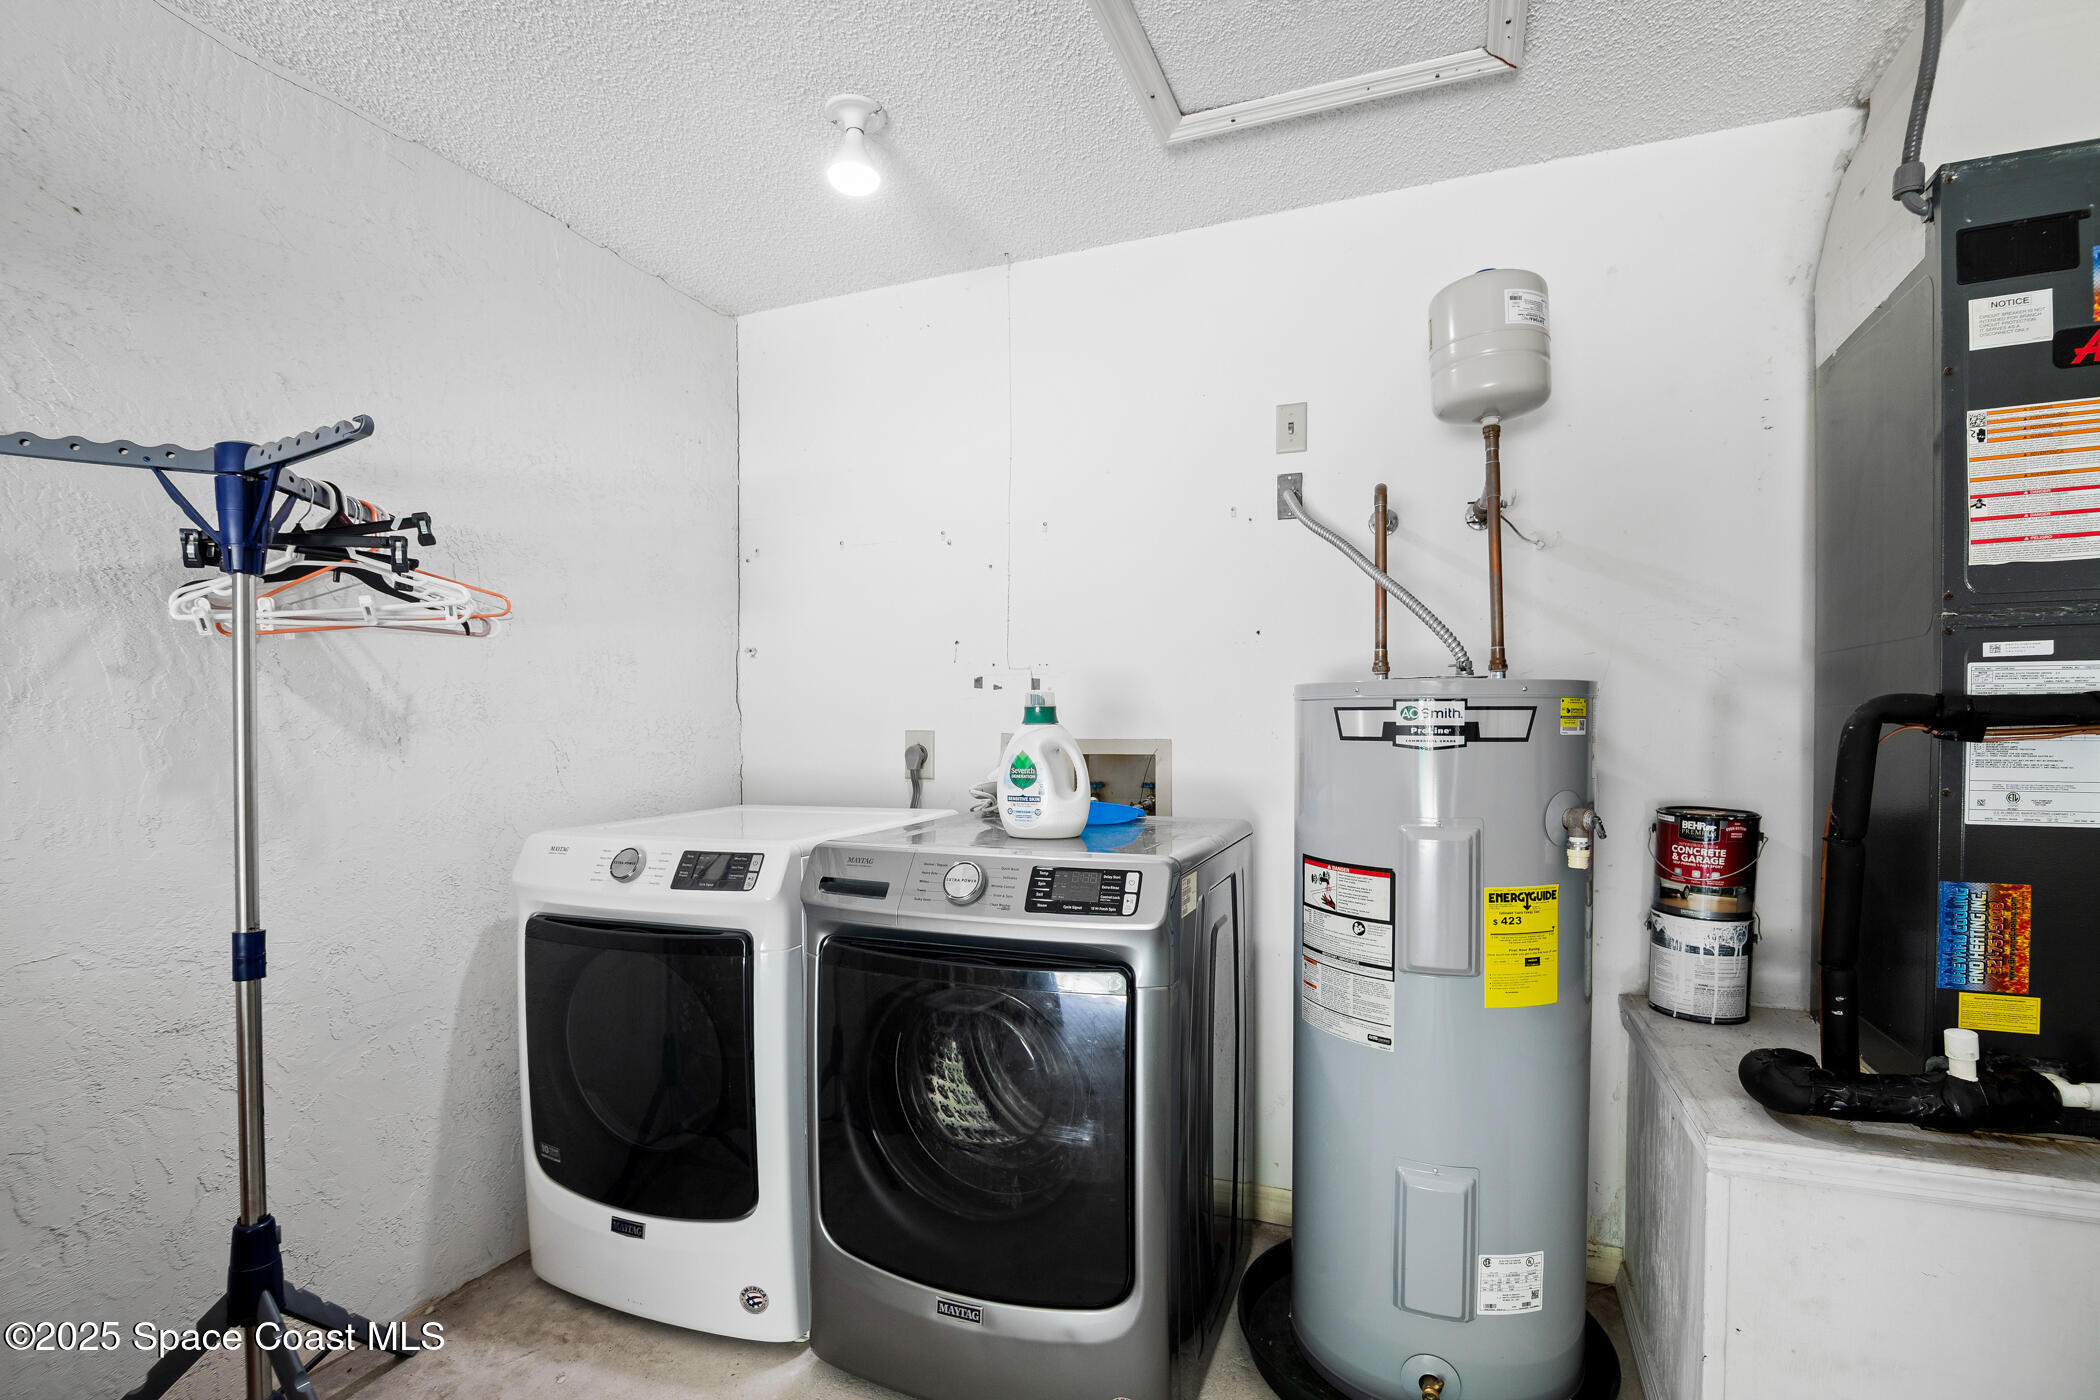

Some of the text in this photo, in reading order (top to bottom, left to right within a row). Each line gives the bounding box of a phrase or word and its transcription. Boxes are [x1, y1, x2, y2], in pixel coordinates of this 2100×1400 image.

[1990, 296, 2030, 308] NOTICE
[1011, 766, 1036, 774] Seventh
[1682, 820, 1706, 831] BEHR
[1672, 844, 1726, 857] CONCRETE
[1672, 852, 1726, 865] & GARAGE
[1488, 890, 1557, 904] ENERGYGUIDE
[1501, 916, 1522, 925] 423
[1952, 887, 1969, 984] BREVARD COOLING
[1968, 891, 1988, 984] AND HEATING INC.
[612, 1220, 642, 1237] MAYTAG
[742, 1286, 766, 1298] AMERICA
[938, 1302, 980, 1321] MAYTAG
